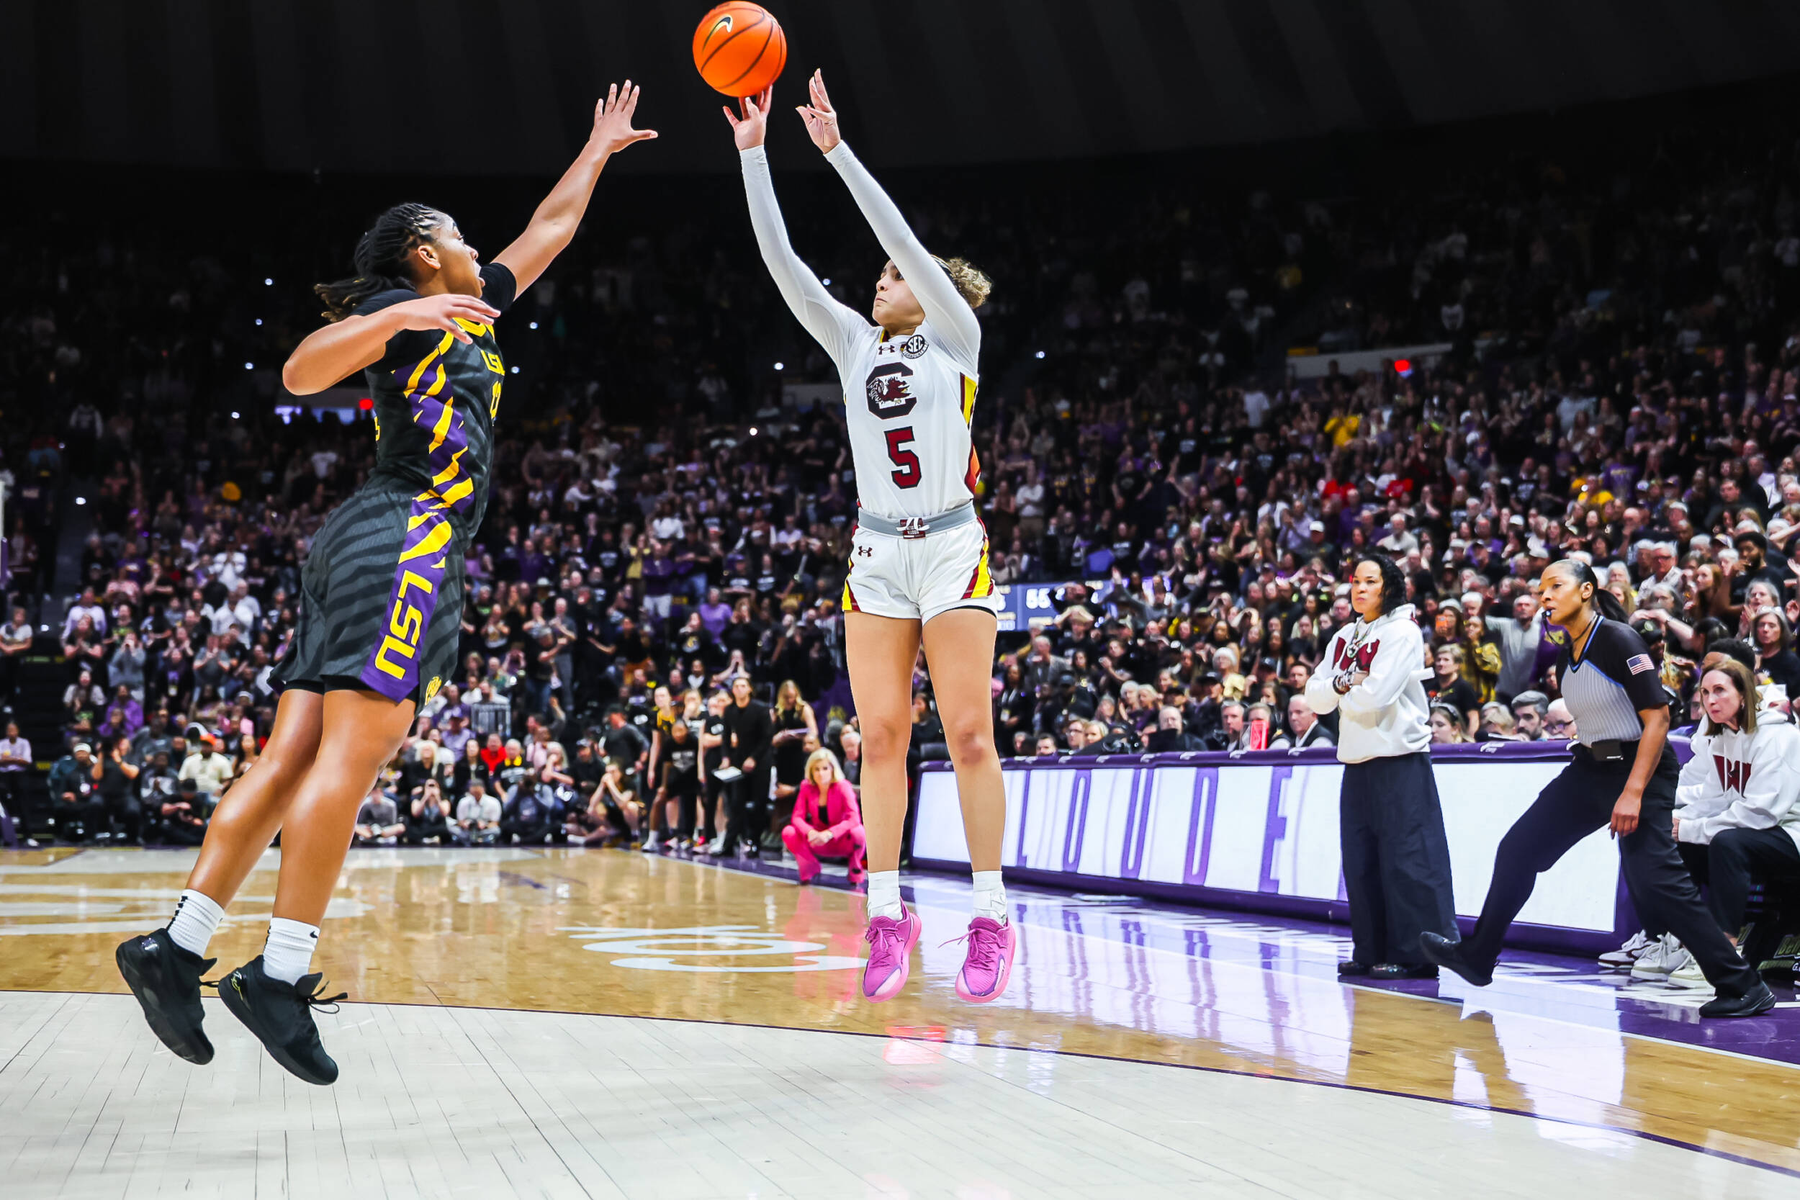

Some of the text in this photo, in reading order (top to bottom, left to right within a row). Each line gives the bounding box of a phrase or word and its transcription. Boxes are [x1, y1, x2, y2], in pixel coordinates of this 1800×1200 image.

[907, 336, 925, 353] SEC
[884, 426, 922, 489] 5
[374, 569, 433, 681] LSU
[1016, 765, 1348, 902] LOUDE
